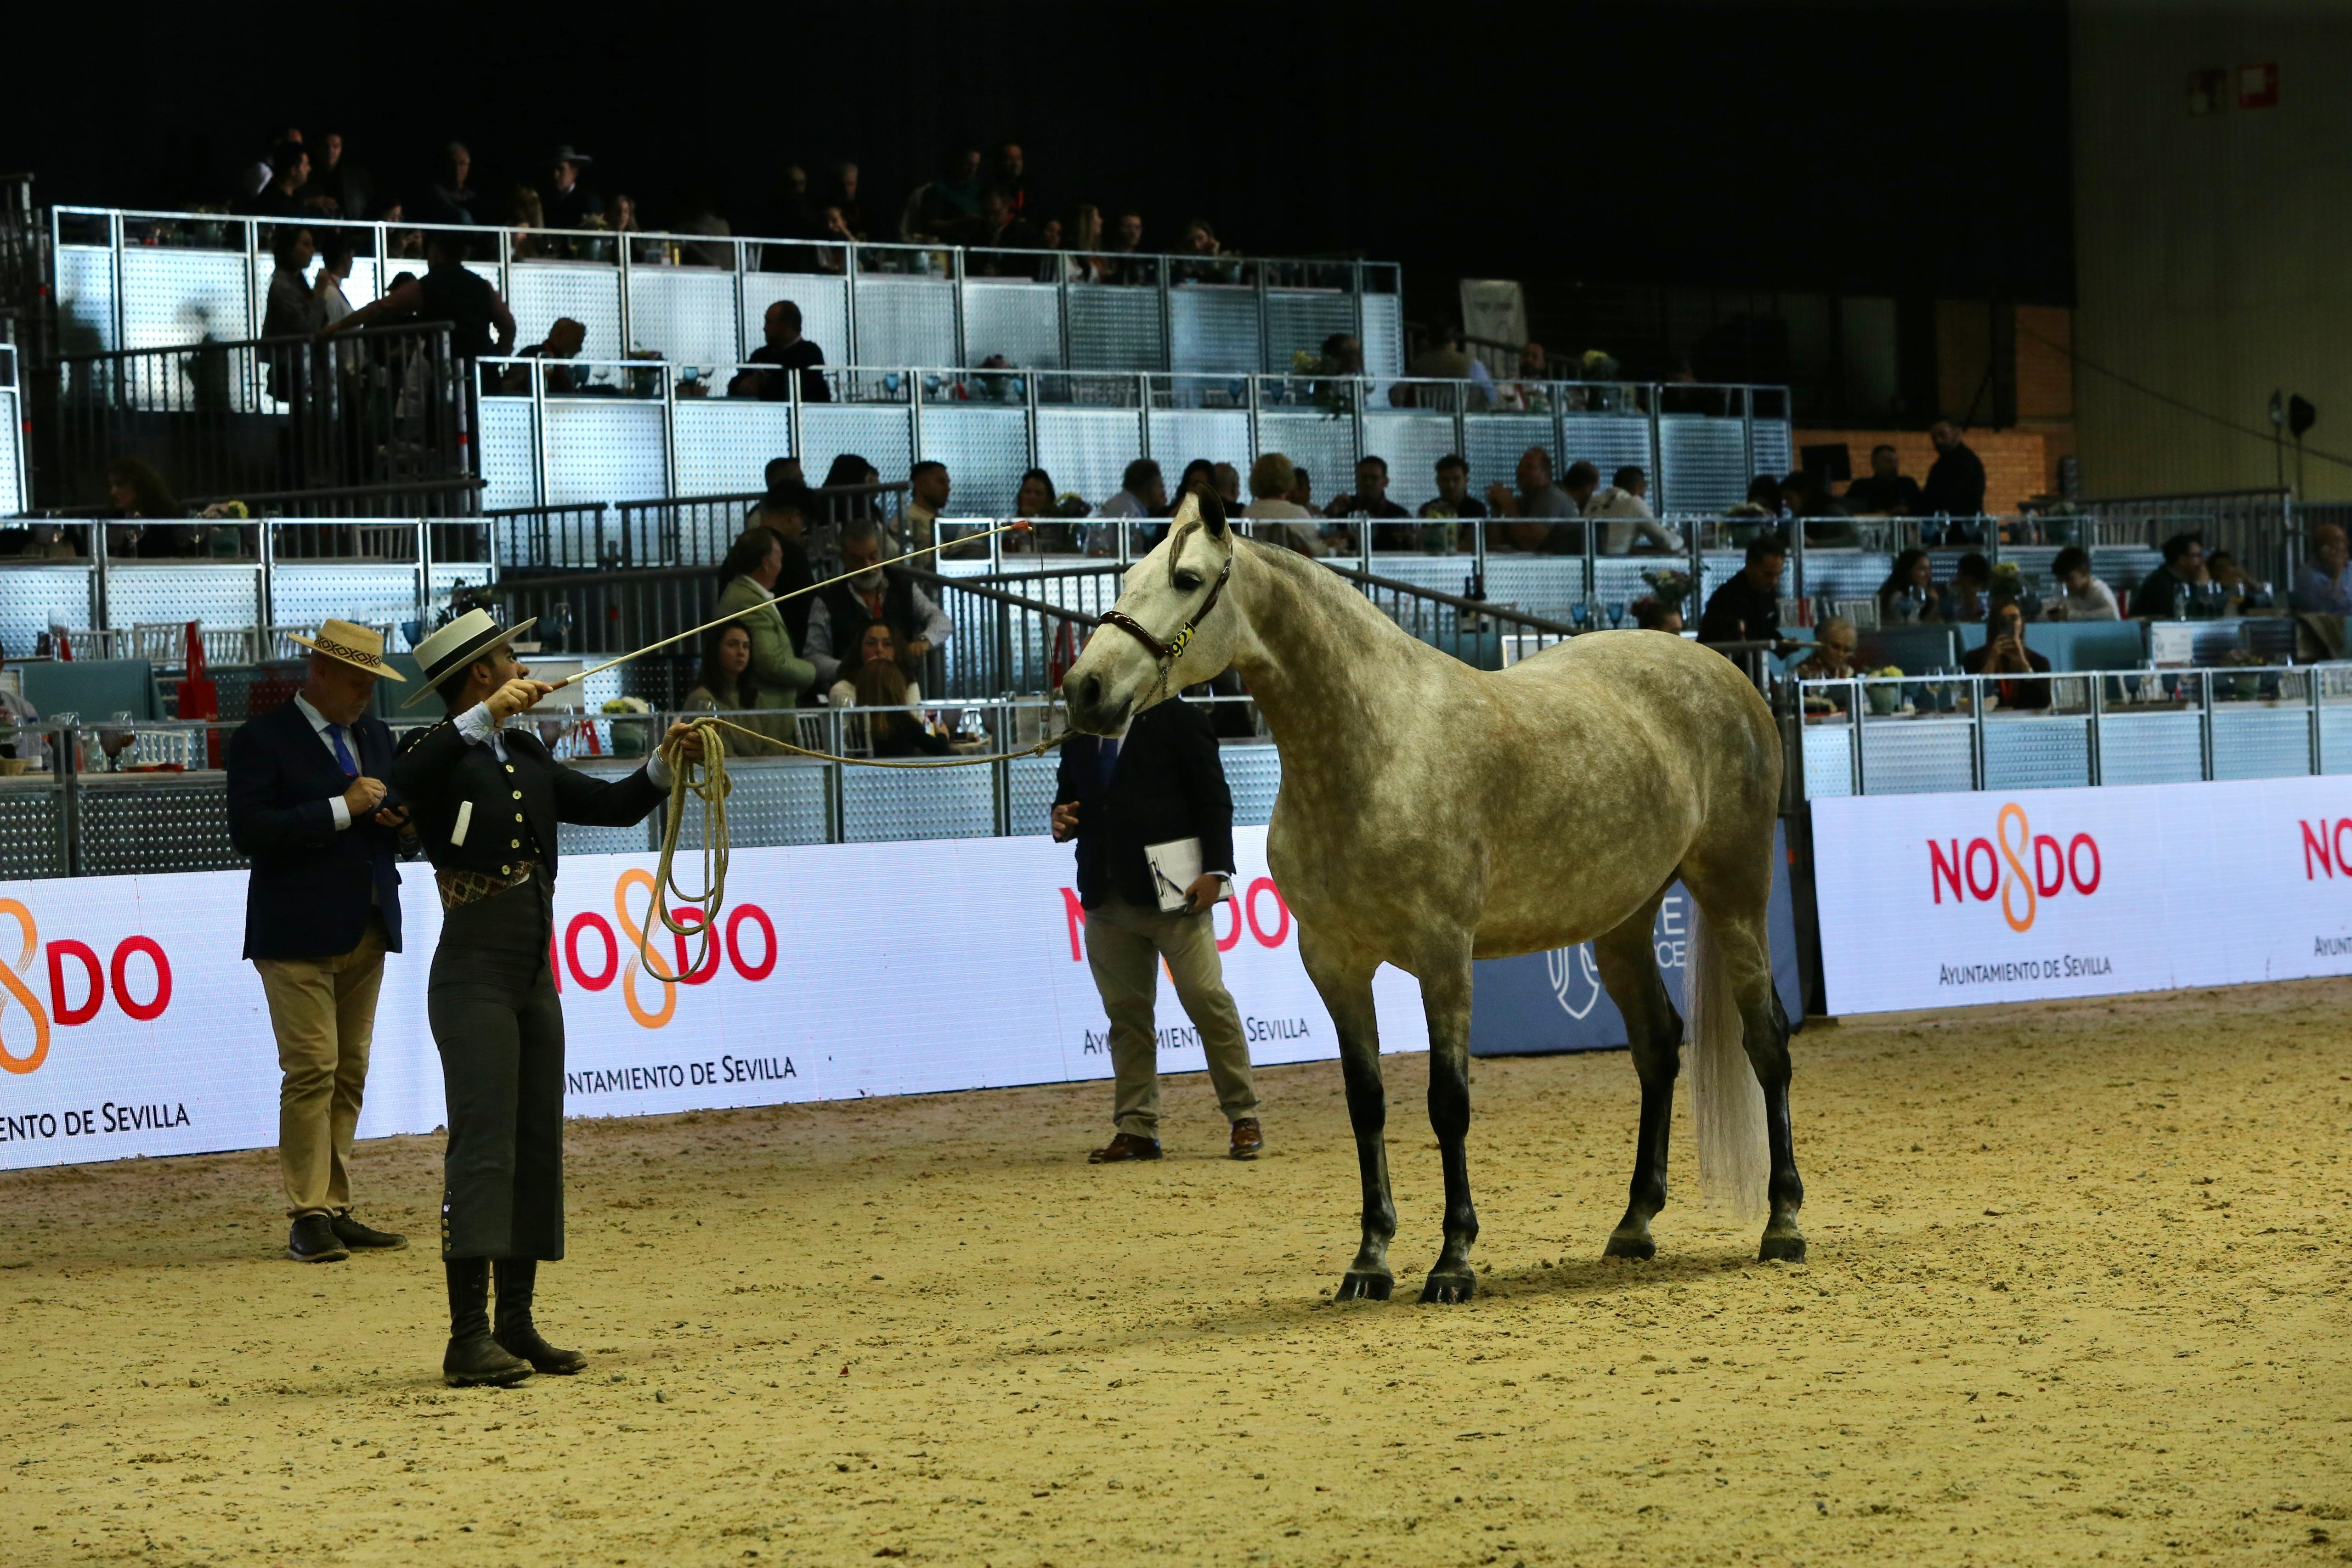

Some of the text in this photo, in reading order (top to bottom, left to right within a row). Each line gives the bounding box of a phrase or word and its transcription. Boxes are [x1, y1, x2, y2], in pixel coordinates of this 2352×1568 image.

[1939, 954, 2112, 986] AYUNTAMIENTO DE SEVILLA
[1246, 1016, 1311, 1042] SEVILLA
[564, 1055, 797, 1095] NTAMIENTO DE SEVILLA
[63, 1110, 96, 1137] DE
[102, 1102, 191, 1133] SEVILLA
